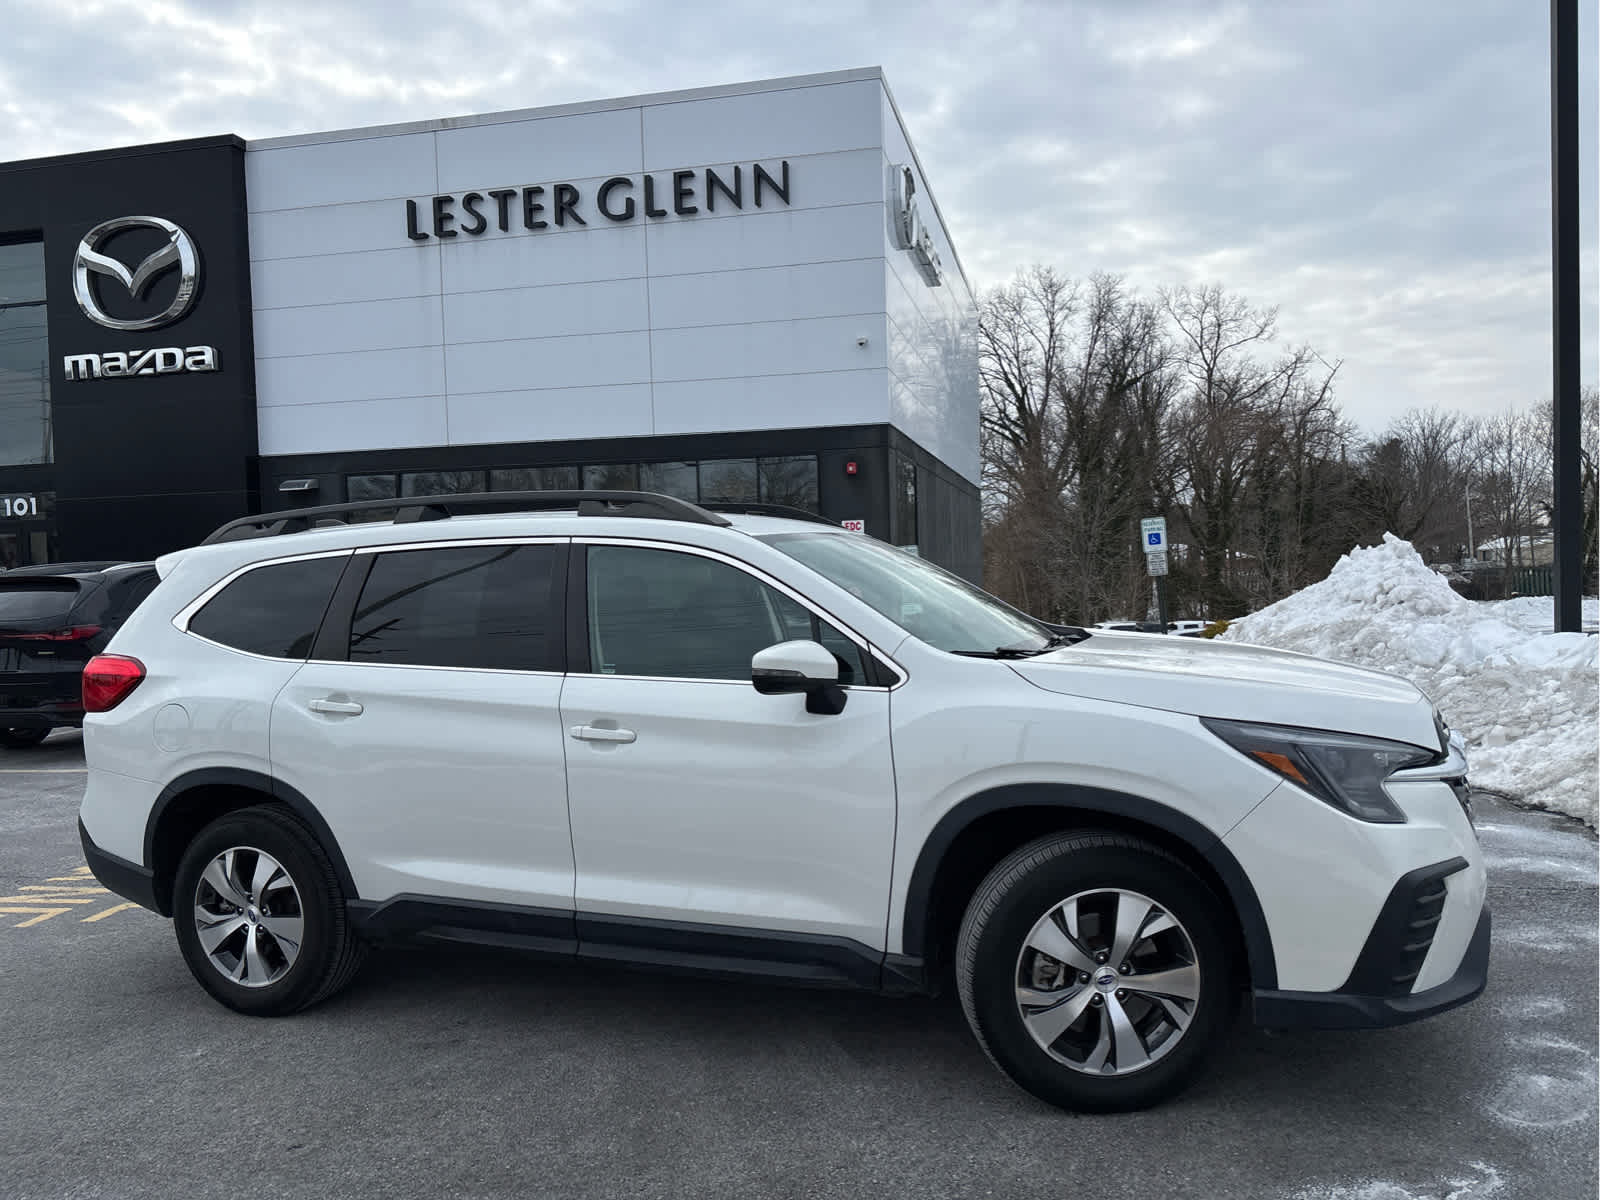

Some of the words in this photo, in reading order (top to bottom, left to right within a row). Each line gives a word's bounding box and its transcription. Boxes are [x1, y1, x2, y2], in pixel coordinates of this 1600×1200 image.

[406, 182, 587, 242] LESTER
[596, 160, 791, 222] GLENN
[4, 497, 37, 517] 101
